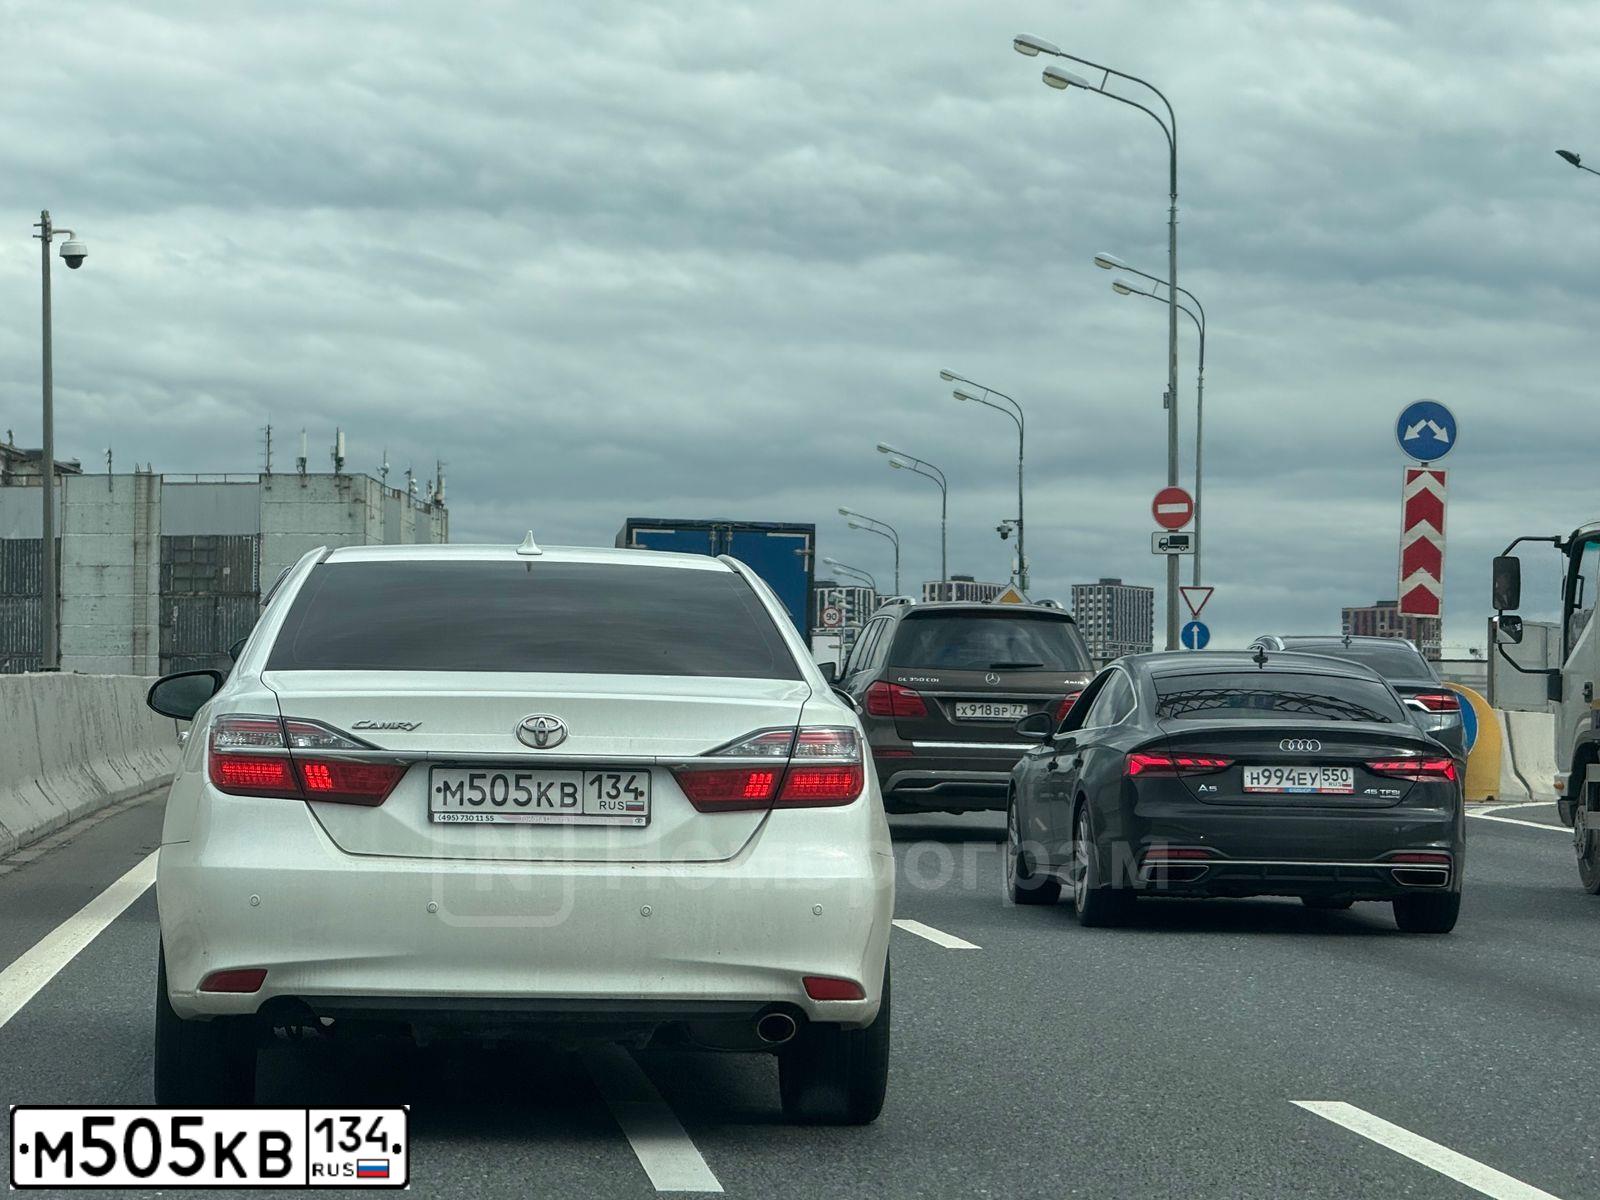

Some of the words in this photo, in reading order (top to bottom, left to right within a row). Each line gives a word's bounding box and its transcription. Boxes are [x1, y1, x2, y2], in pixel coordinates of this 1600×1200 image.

[826, 612, 837, 621] 90
[1012, 705, 1024, 714] 77
[352, 720, 422, 732] CAMRY
[1250, 768, 1318, 786] Н994ЕУ
[1322, 768, 1349, 782] 550
[443, 774, 578, 808] М505КВ
[589, 774, 639, 801] 134
[1198, 784, 1218, 792] A5
[599, 801, 625, 810] RUS
